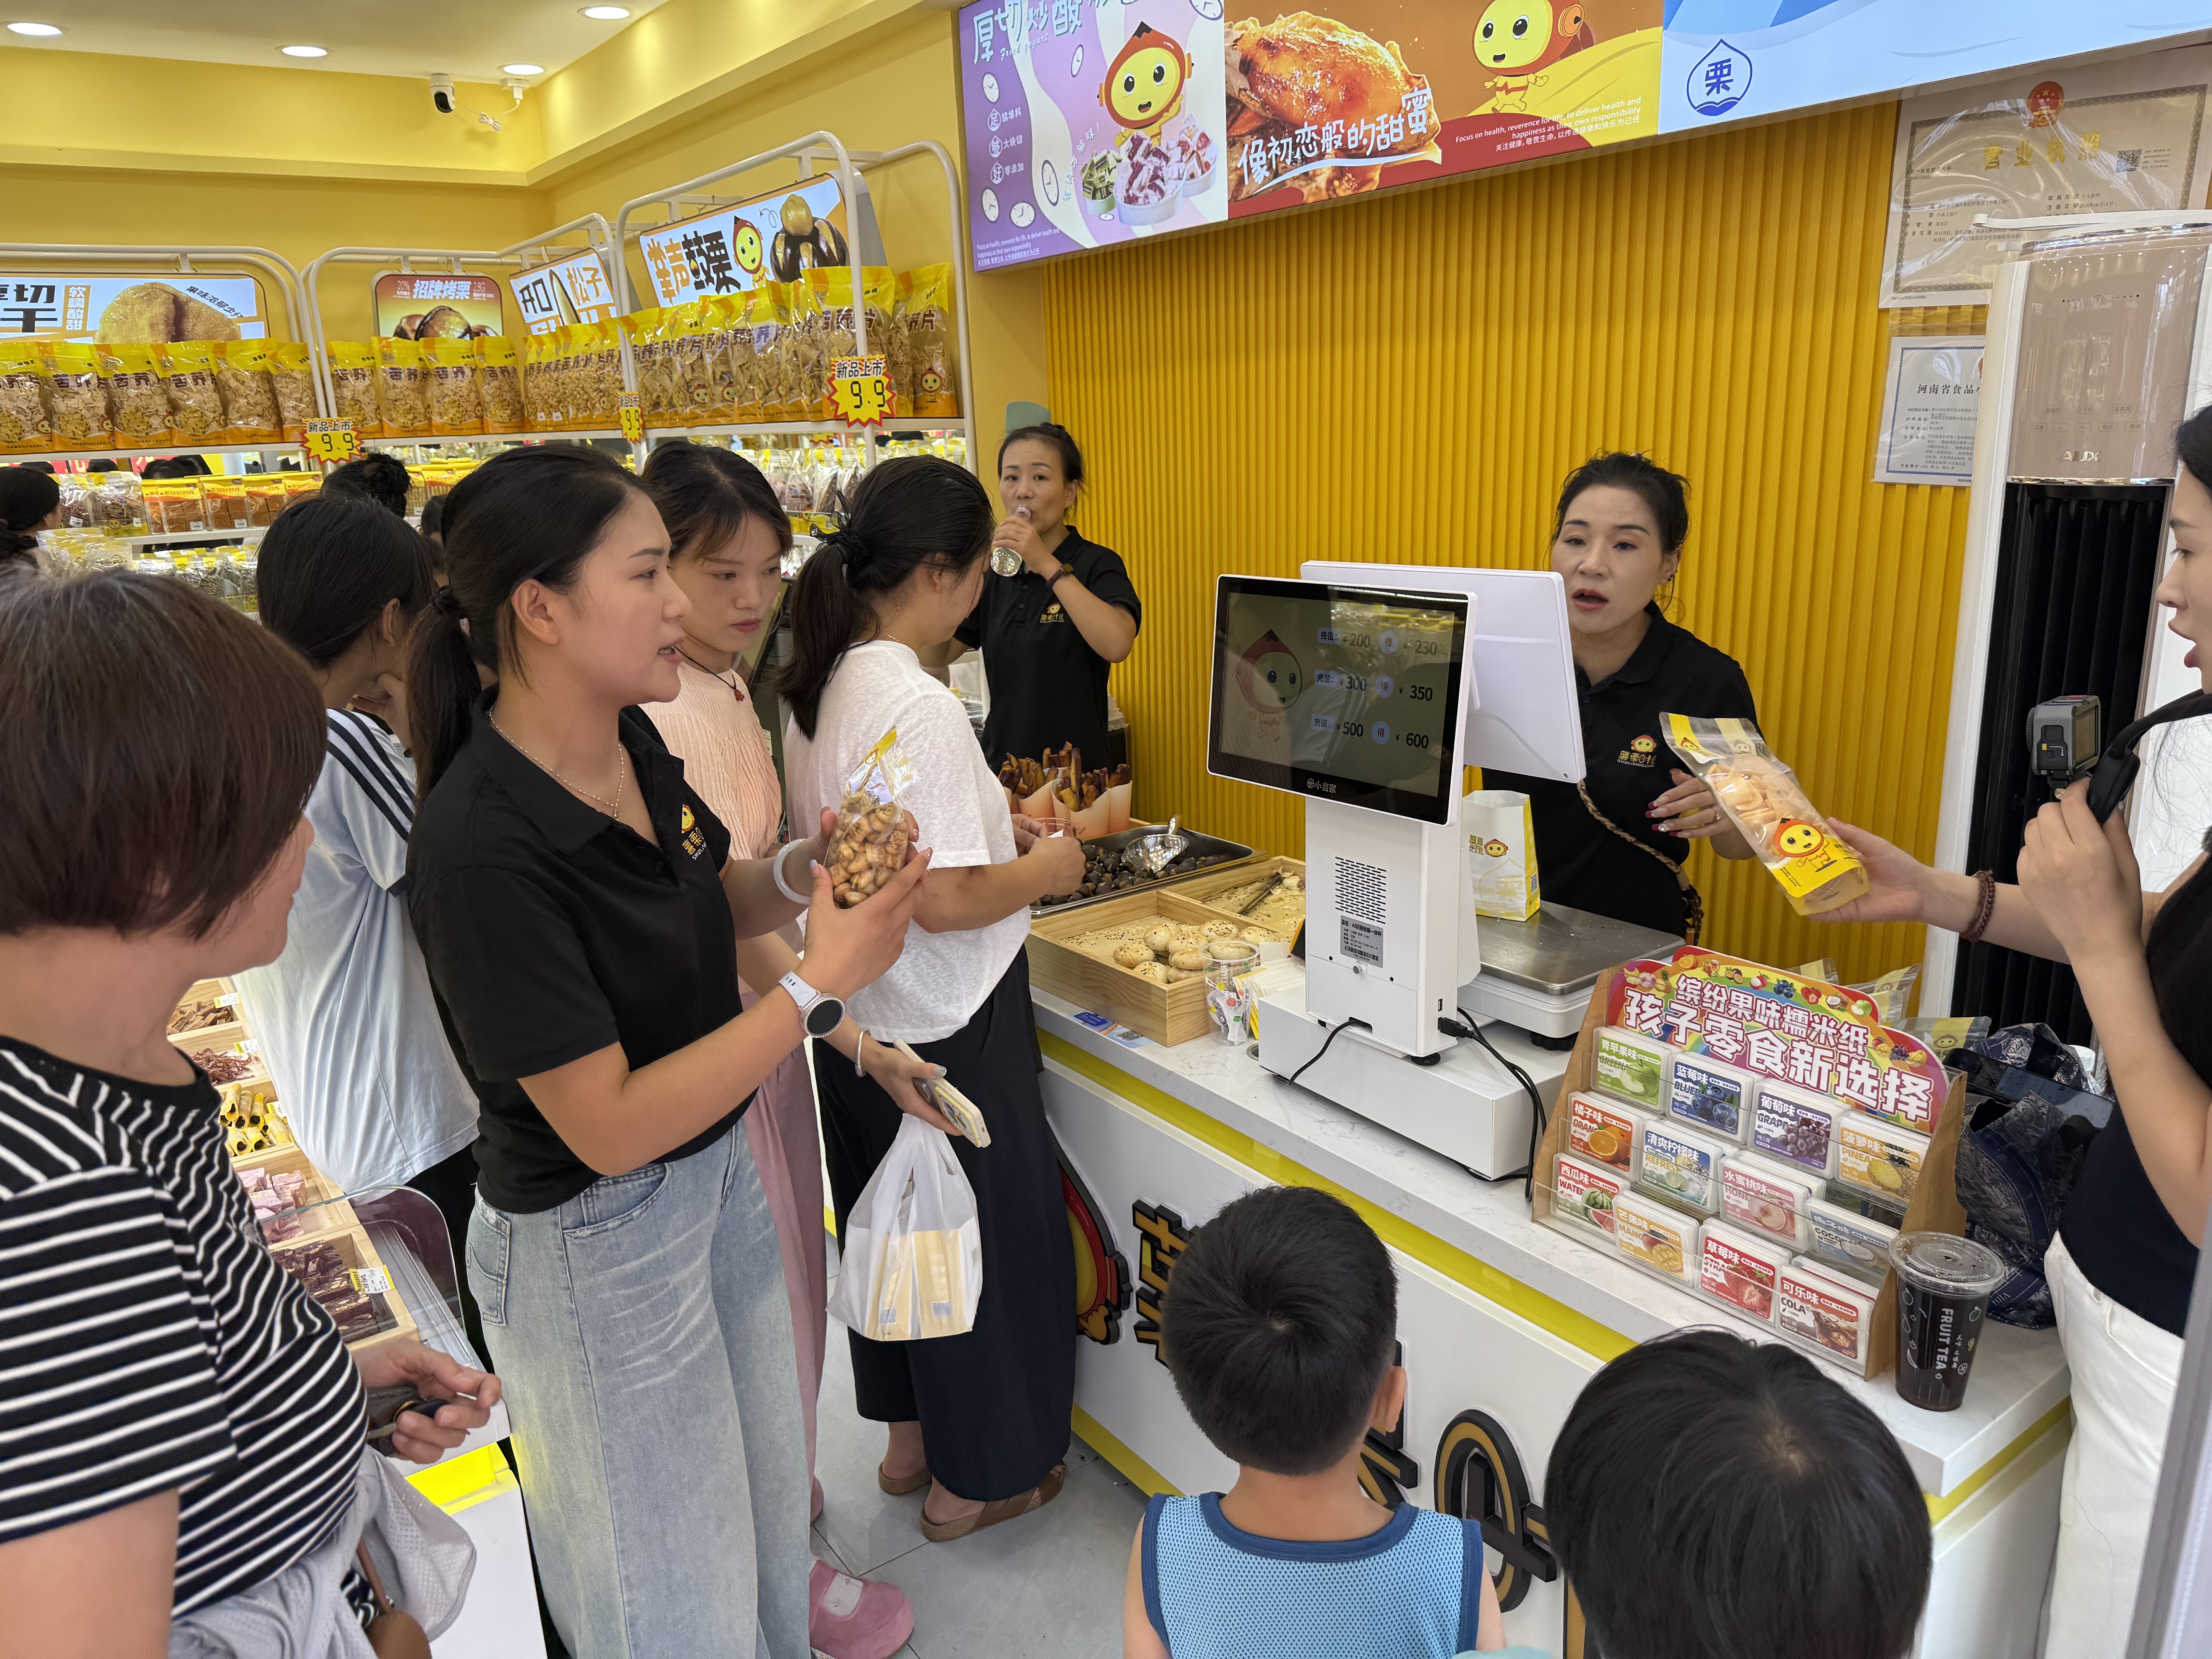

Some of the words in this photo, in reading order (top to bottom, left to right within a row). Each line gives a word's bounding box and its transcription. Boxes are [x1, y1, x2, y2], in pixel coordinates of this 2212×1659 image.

[1705, 58, 1734, 96] 栗
[990, 112, 999, 127] 足
[1484, 126, 1507, 137] health,
[1508, 120, 1540, 131] reverence
[1552, 115, 1565, 123] life,
[1575, 106, 1601, 116] deliver
[1602, 101, 1625, 111] health
[1627, 96, 1641, 105] and
[1512, 128, 1546, 140] happiness
[1556, 121, 1573, 130] their
[1591, 107, 1641, 124] responsibility
[1003, 135, 1023, 149] 大块切
[1237, 86, 1432, 185] 像初恋般的甜蜜
[1984, 131, 2100, 171] 营业执照
[993, 166, 1001, 180] 好
[1005, 163, 1024, 175] 零添加
[413, 280, 471, 300] 招牌烤栗
[566, 267, 603, 306] 松子
[906, 308, 936, 333] 荞片
[113, 372, 161, 389] 苦荞
[171, 370, 215, 389] 苦荞
[836, 360, 883, 379] 新品上市
[850, 380, 886, 409] 9.9
[308, 420, 351, 433] 新品上市
[626, 410, 641, 431] 9.9
[321, 433, 354, 452] 9.9
[2059, 450, 2102, 462] AUX
[1414, 640, 1438, 656] 230
[1381, 681, 1389, 691] 得
[1409, 685, 1433, 701] 350
[1406, 732, 1429, 749] 600
[1675, 974, 1870, 1057] 缤纷果味糯米纸
[1601, 1039, 1637, 1060] 青苹果味
[1625, 986, 1933, 1122] 孩子零食新选择
[1676, 1064, 1709, 1085] 蓝莓味
[1574, 1103, 1603, 1123] 橘子味
[1761, 1095, 1795, 1117] 葡萄味
[1647, 1132, 1699, 1162] 清爽柠檬味
[1843, 1130, 1880, 1153] 菠萝味
[1561, 1163, 1590, 1185] 西瓜味
[1724, 1170, 1768, 1195] 水蜜桃味
[1617, 1208, 1649, 1230] 芒果味
[1706, 1239, 1740, 1264] 草莓味
[1703, 1256, 1728, 1271] STRA
[1782, 1279, 1819, 1305] 可乐味
[1781, 1297, 1807, 1316] COLA
[1939, 1307, 1954, 1345] FRUIT
[1935, 1347, 1949, 1370] TEA
